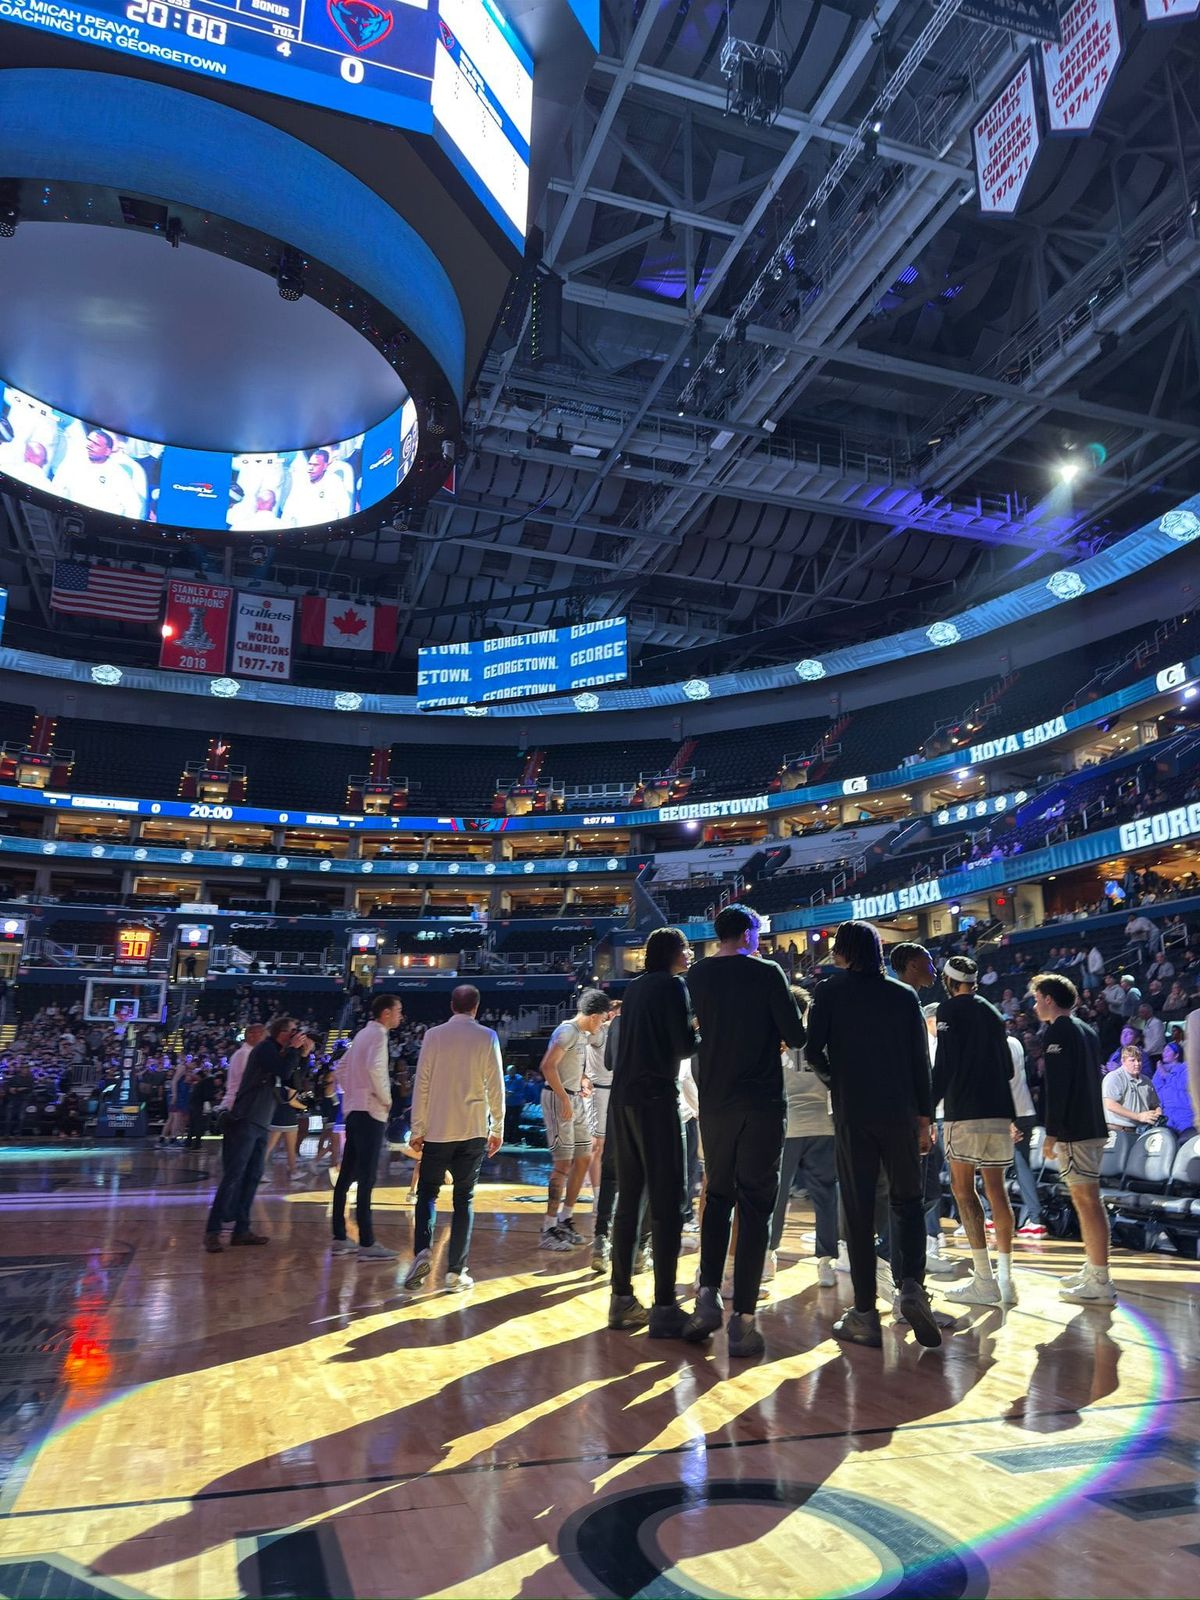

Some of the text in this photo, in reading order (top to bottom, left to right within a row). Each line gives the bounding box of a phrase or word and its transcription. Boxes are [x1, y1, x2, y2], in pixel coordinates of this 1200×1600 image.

[30, 0, 140, 38] MICAH PEAVY!
[126, 0, 227, 46] 20:00
[251, 0, 290, 18] BONUS
[272, 23, 295, 39] TOL
[1059, 19, 1100, 74] EASTERN
[77, 24, 112, 43] OUR
[115, 34, 227, 75] GEORGETOWN
[276, 41, 292, 57] 4
[1052, 20, 1112, 97] CONFERENCE
[340, 57, 365, 84] 0
[1055, 38, 1111, 108] CHAMPIONS
[977, 67, 1028, 138] BALTIMORE
[1062, 65, 1108, 125] 1974-75
[987, 93, 1021, 141] BULLETS
[982, 115, 1032, 180] CONFERENCE
[988, 112, 1022, 159] EASTERN
[984, 131, 1031, 192] CHAMPIONS
[991, 155, 1030, 207] 1970-71
[171, 584, 230, 599] STANLEY CUP
[174, 594, 225, 609] CHAMPIONS
[239, 605, 292, 621] bullets
[255, 622, 274, 633] NBA
[236, 641, 290, 656] CHAMPIONS
[247, 632, 280, 644] WORLD
[571, 640, 627, 667] GEORGE
[180, 656, 206, 669] 2018
[238, 656, 285, 672] 1977-78
[969, 716, 1068, 764] HOYA SAXA
[190, 804, 233, 820] 20:00
[659, 795, 769, 822] GEORGETOWN
[1120, 802, 1200, 851] GEORG
[851, 880, 942, 920] HOYA SAXA
[120, 941, 147, 957] 30
